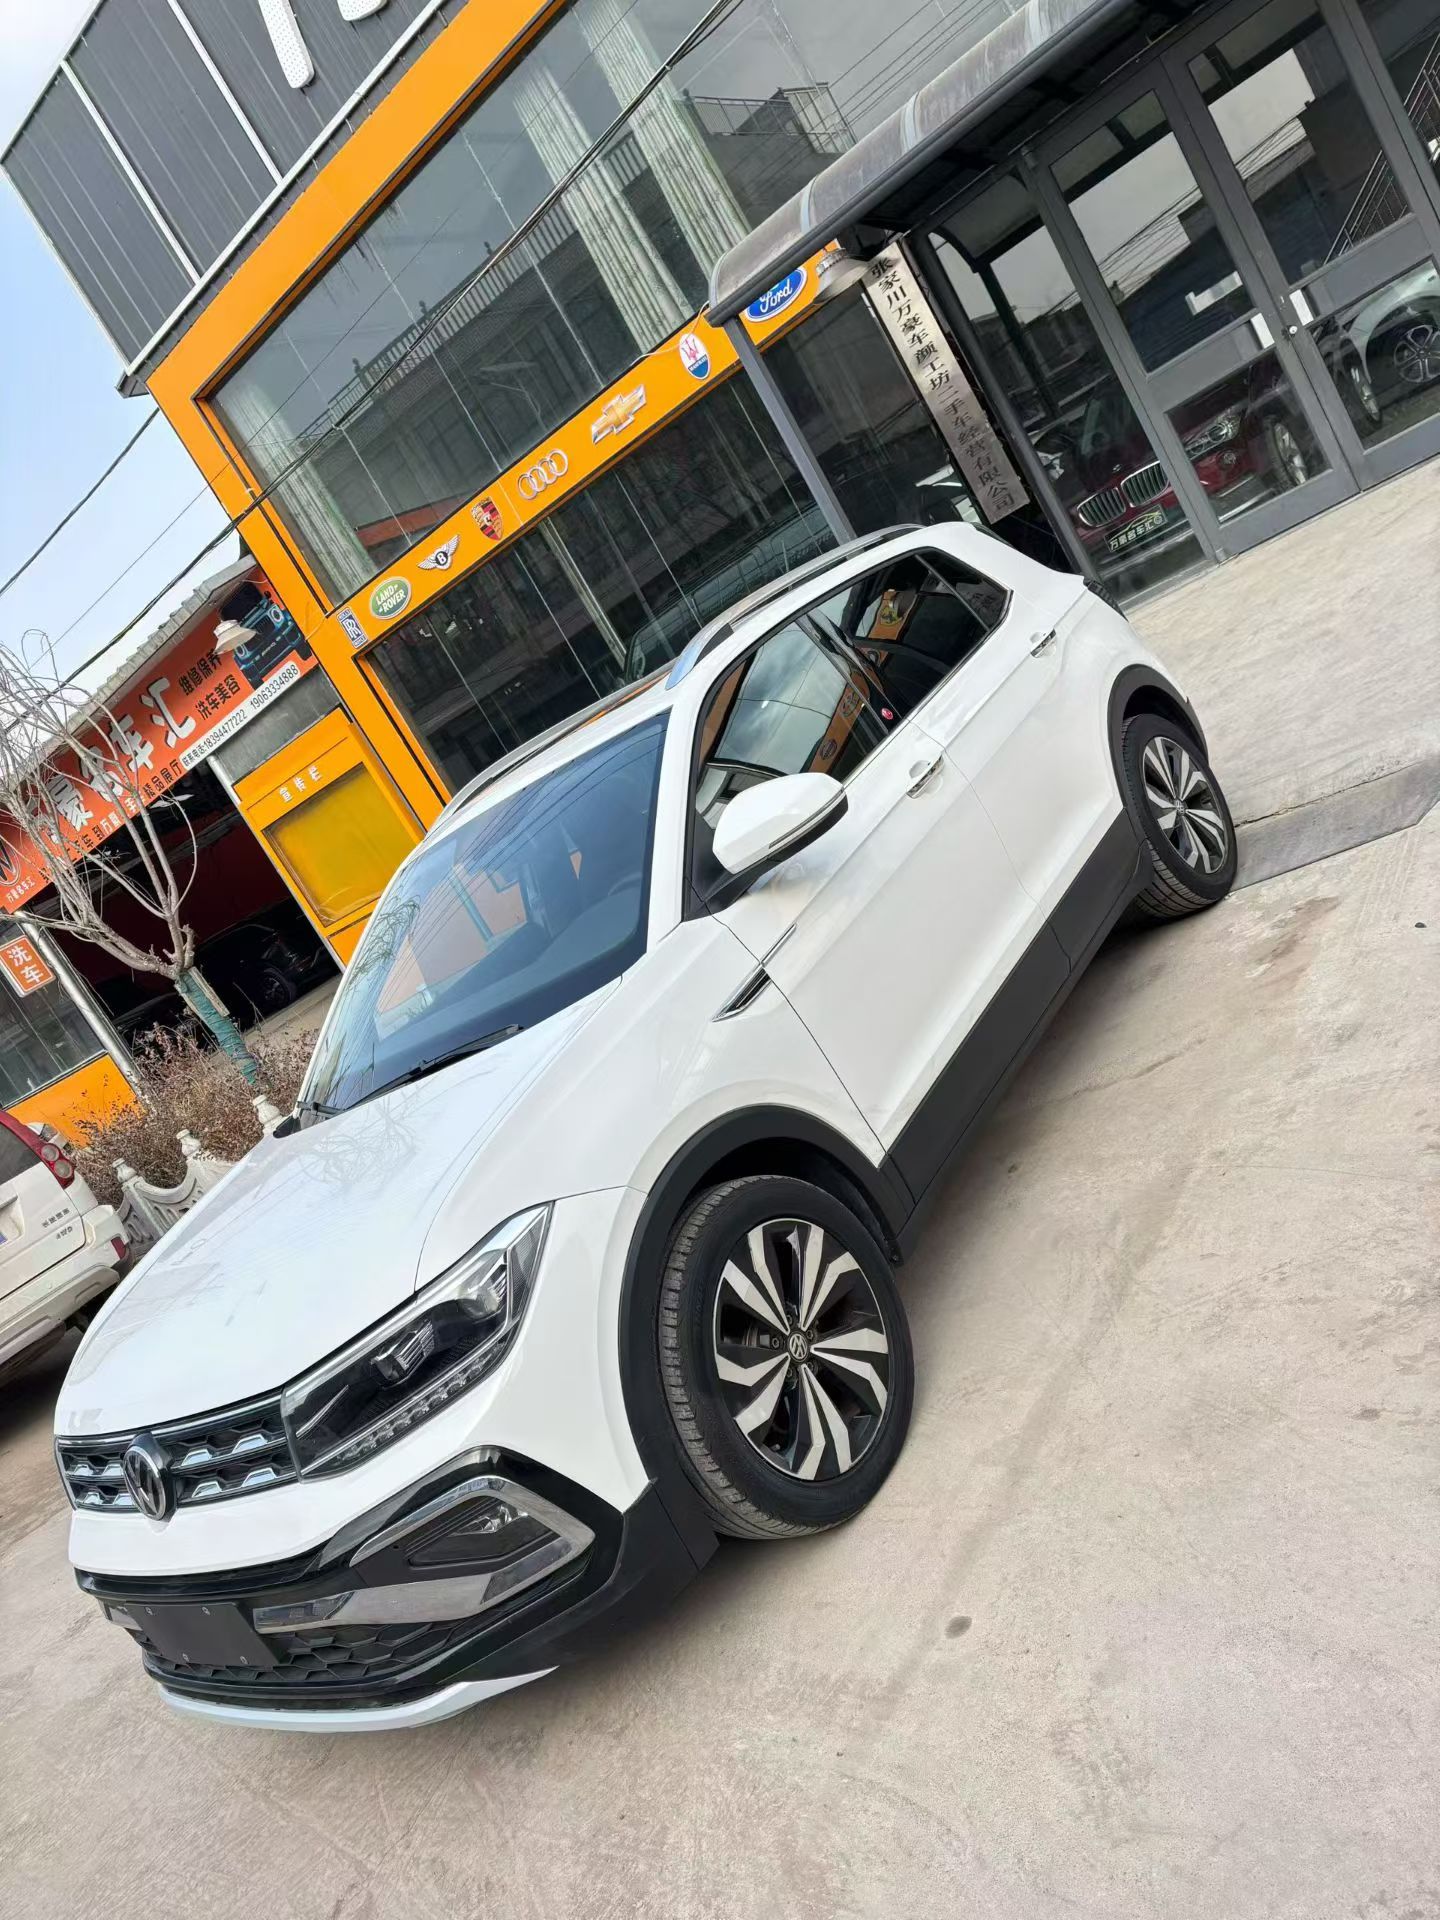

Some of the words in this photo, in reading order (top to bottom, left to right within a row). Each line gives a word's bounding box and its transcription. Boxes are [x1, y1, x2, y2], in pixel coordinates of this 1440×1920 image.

[760, 279, 793, 313] Ford
[871, 256, 1014, 510] 张家川万豪车颜工坊二手车经营有限公司
[375, 584, 395, 606] LAND
[382, 590, 406, 614] ROVER
[178, 648, 223, 696] 维修保养
[250, 664, 299, 710] 19063334888
[195, 674, 241, 721] 洗车美容
[6, 945, 44, 984] 洗车
